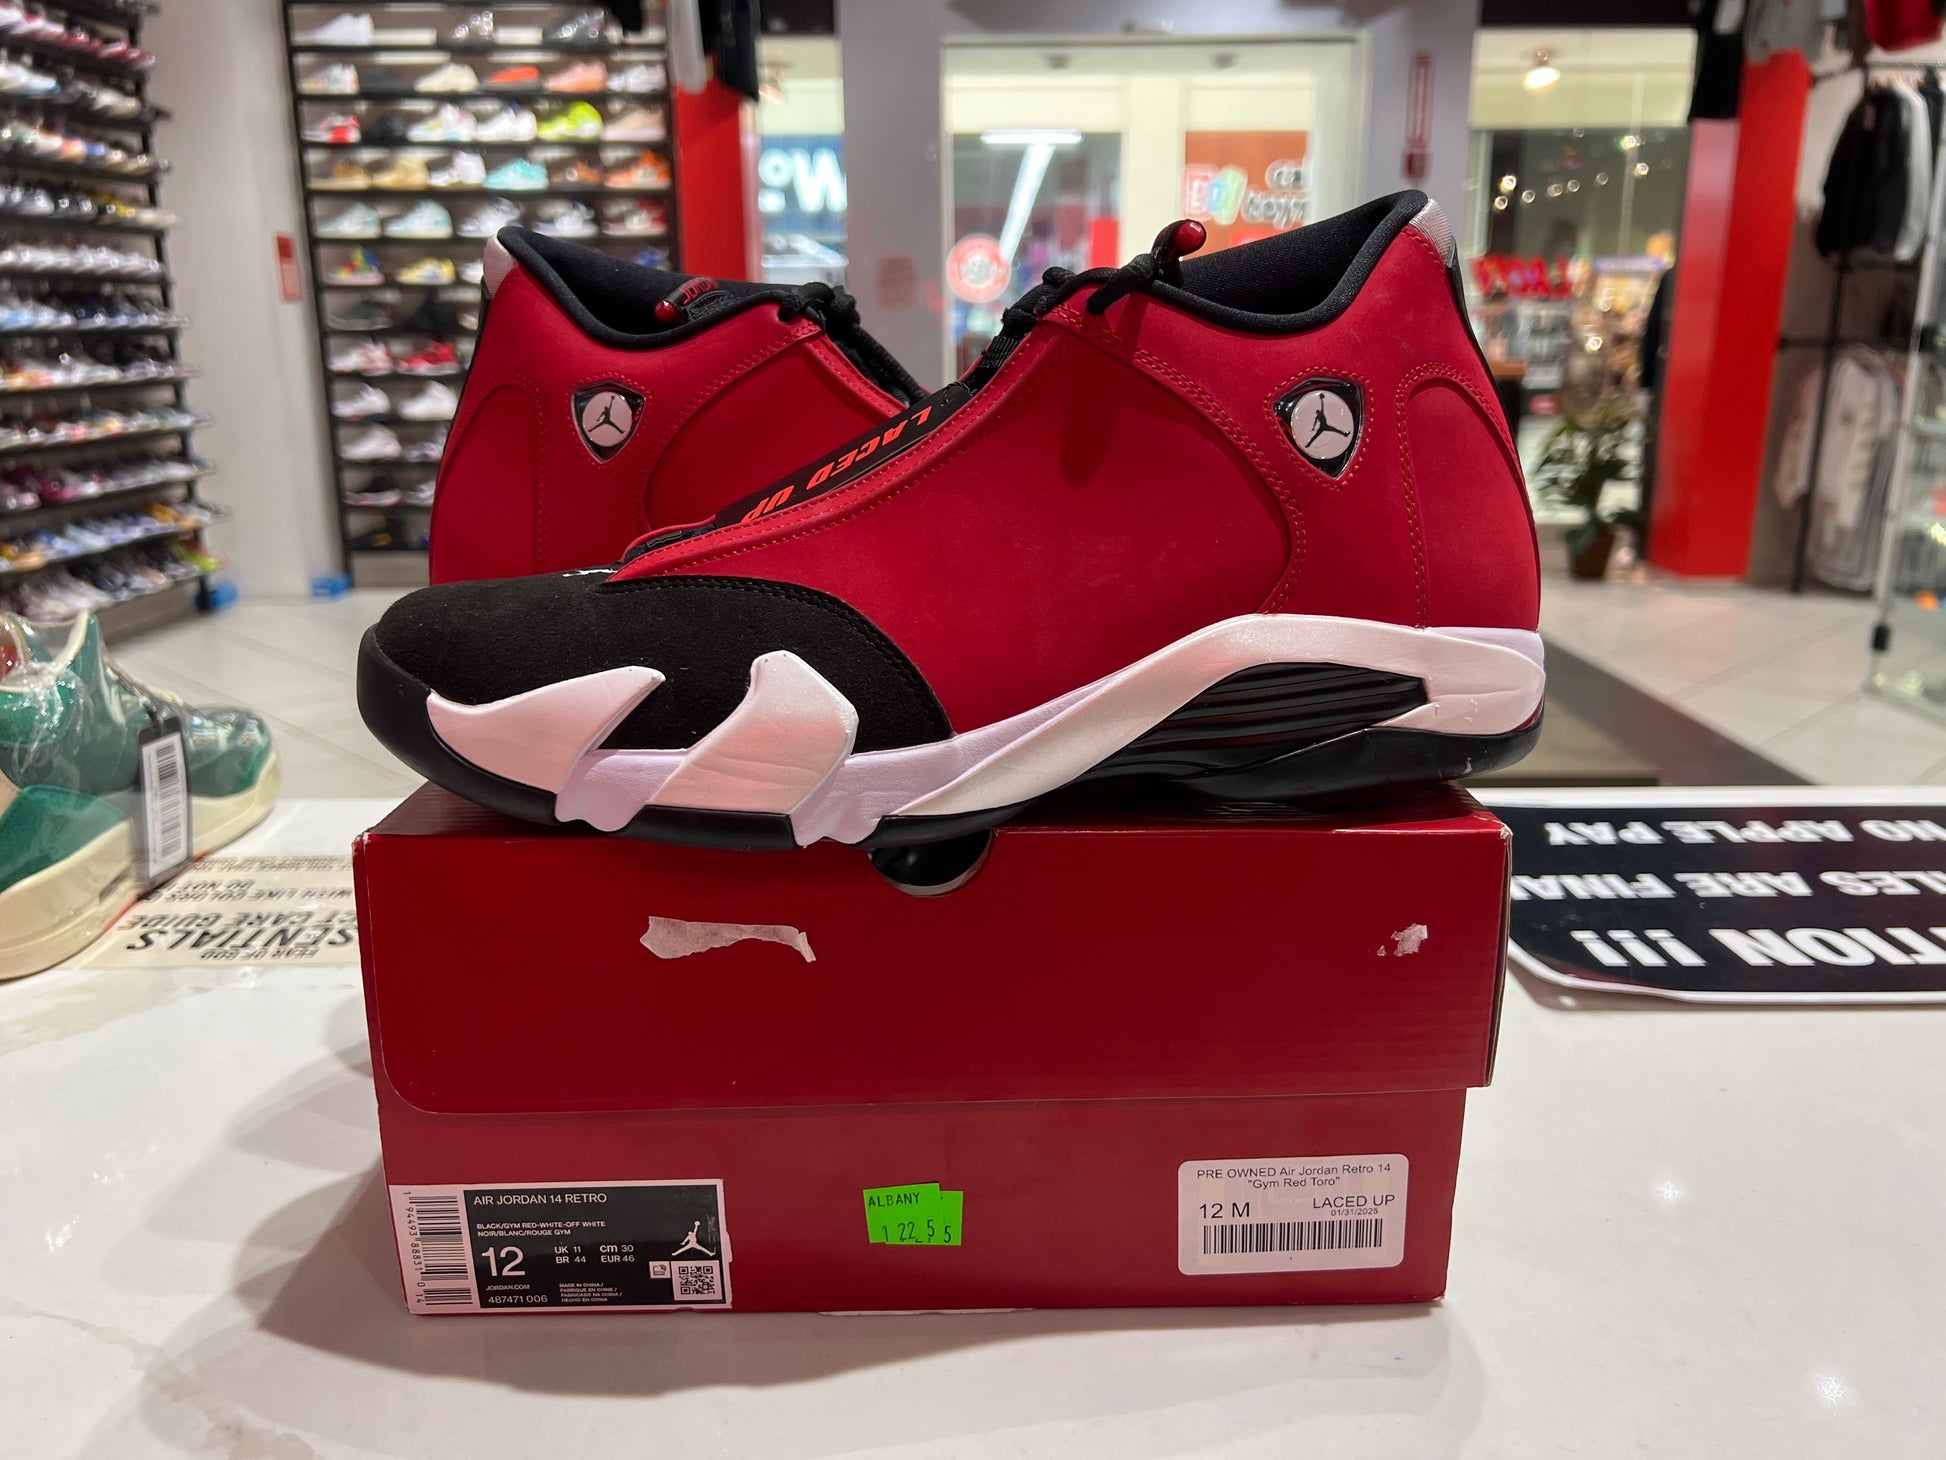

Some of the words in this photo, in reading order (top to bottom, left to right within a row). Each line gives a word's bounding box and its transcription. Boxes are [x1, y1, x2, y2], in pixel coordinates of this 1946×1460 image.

[806, 405, 934, 490] LACED
[740, 487, 796, 523] UP
[1544, 821, 1665, 845] PAY
[1660, 819, 1855, 843] APPLE
[1674, 871, 1814, 897] ARE
[249, 889, 298, 901] LIKE
[118, 912, 224, 931] GUIDE
[227, 911, 315, 930] CARE
[1709, 927, 1946, 967] TION
[1197, 1169, 1223, 1179] PRE
[1227, 1167, 1277, 1179] OWNED
[1279, 1166, 1295, 1176] Air
[1299, 1165, 1338, 1176] Jordan
[1342, 1164, 1373, 1174] Retro
[1377, 1163, 1391, 1173] 14
[1248, 1178, 1280, 1189] "Gym
[1284, 1177, 1307, 1187] Red
[1311, 1176, 1341, 1186] Toro"
[474, 1194, 494, 1205] AIR
[497, 1194, 547, 1205] JORDAN
[549, 1193, 563, 1204] 14
[565, 1193, 607, 1204] RETRO
[868, 1192, 920, 1207] ALBANY
[1313, 1196, 1368, 1209] LACED
[1373, 1194, 1395, 1207] UP
[1199, 1203, 1223, 1219] 12
[1232, 1202, 1251, 1218] M
[1330, 1207, 1379, 1217] 01/31/2025
[405, 1207, 418, 1237] 94493
[477, 1222, 521, 1230] BLACK/GYM
[521, 1221, 581, 1229] RED-WHITE-OFF
[477, 1229, 553, 1237] NOIR/BLANC/ROUGE
[554, 1228, 571, 1236] GYM
[410, 1242, 423, 1271] 88831
[554, 1246, 568, 1254] UK
[573, 1245, 581, 1253] 11
[599, 1244, 618, 1253] cm
[620, 1244, 634, 1253] 30
[481, 1246, 526, 1277] 12
[555, 1256, 570, 1264] BR
[574, 1255, 587, 1263] 44
[601, 1255, 621, 1263] EUR
[622, 1254, 635, 1263] 46
[488, 1295, 524, 1304] 487471
[526, 1294, 548, 1303] 006
